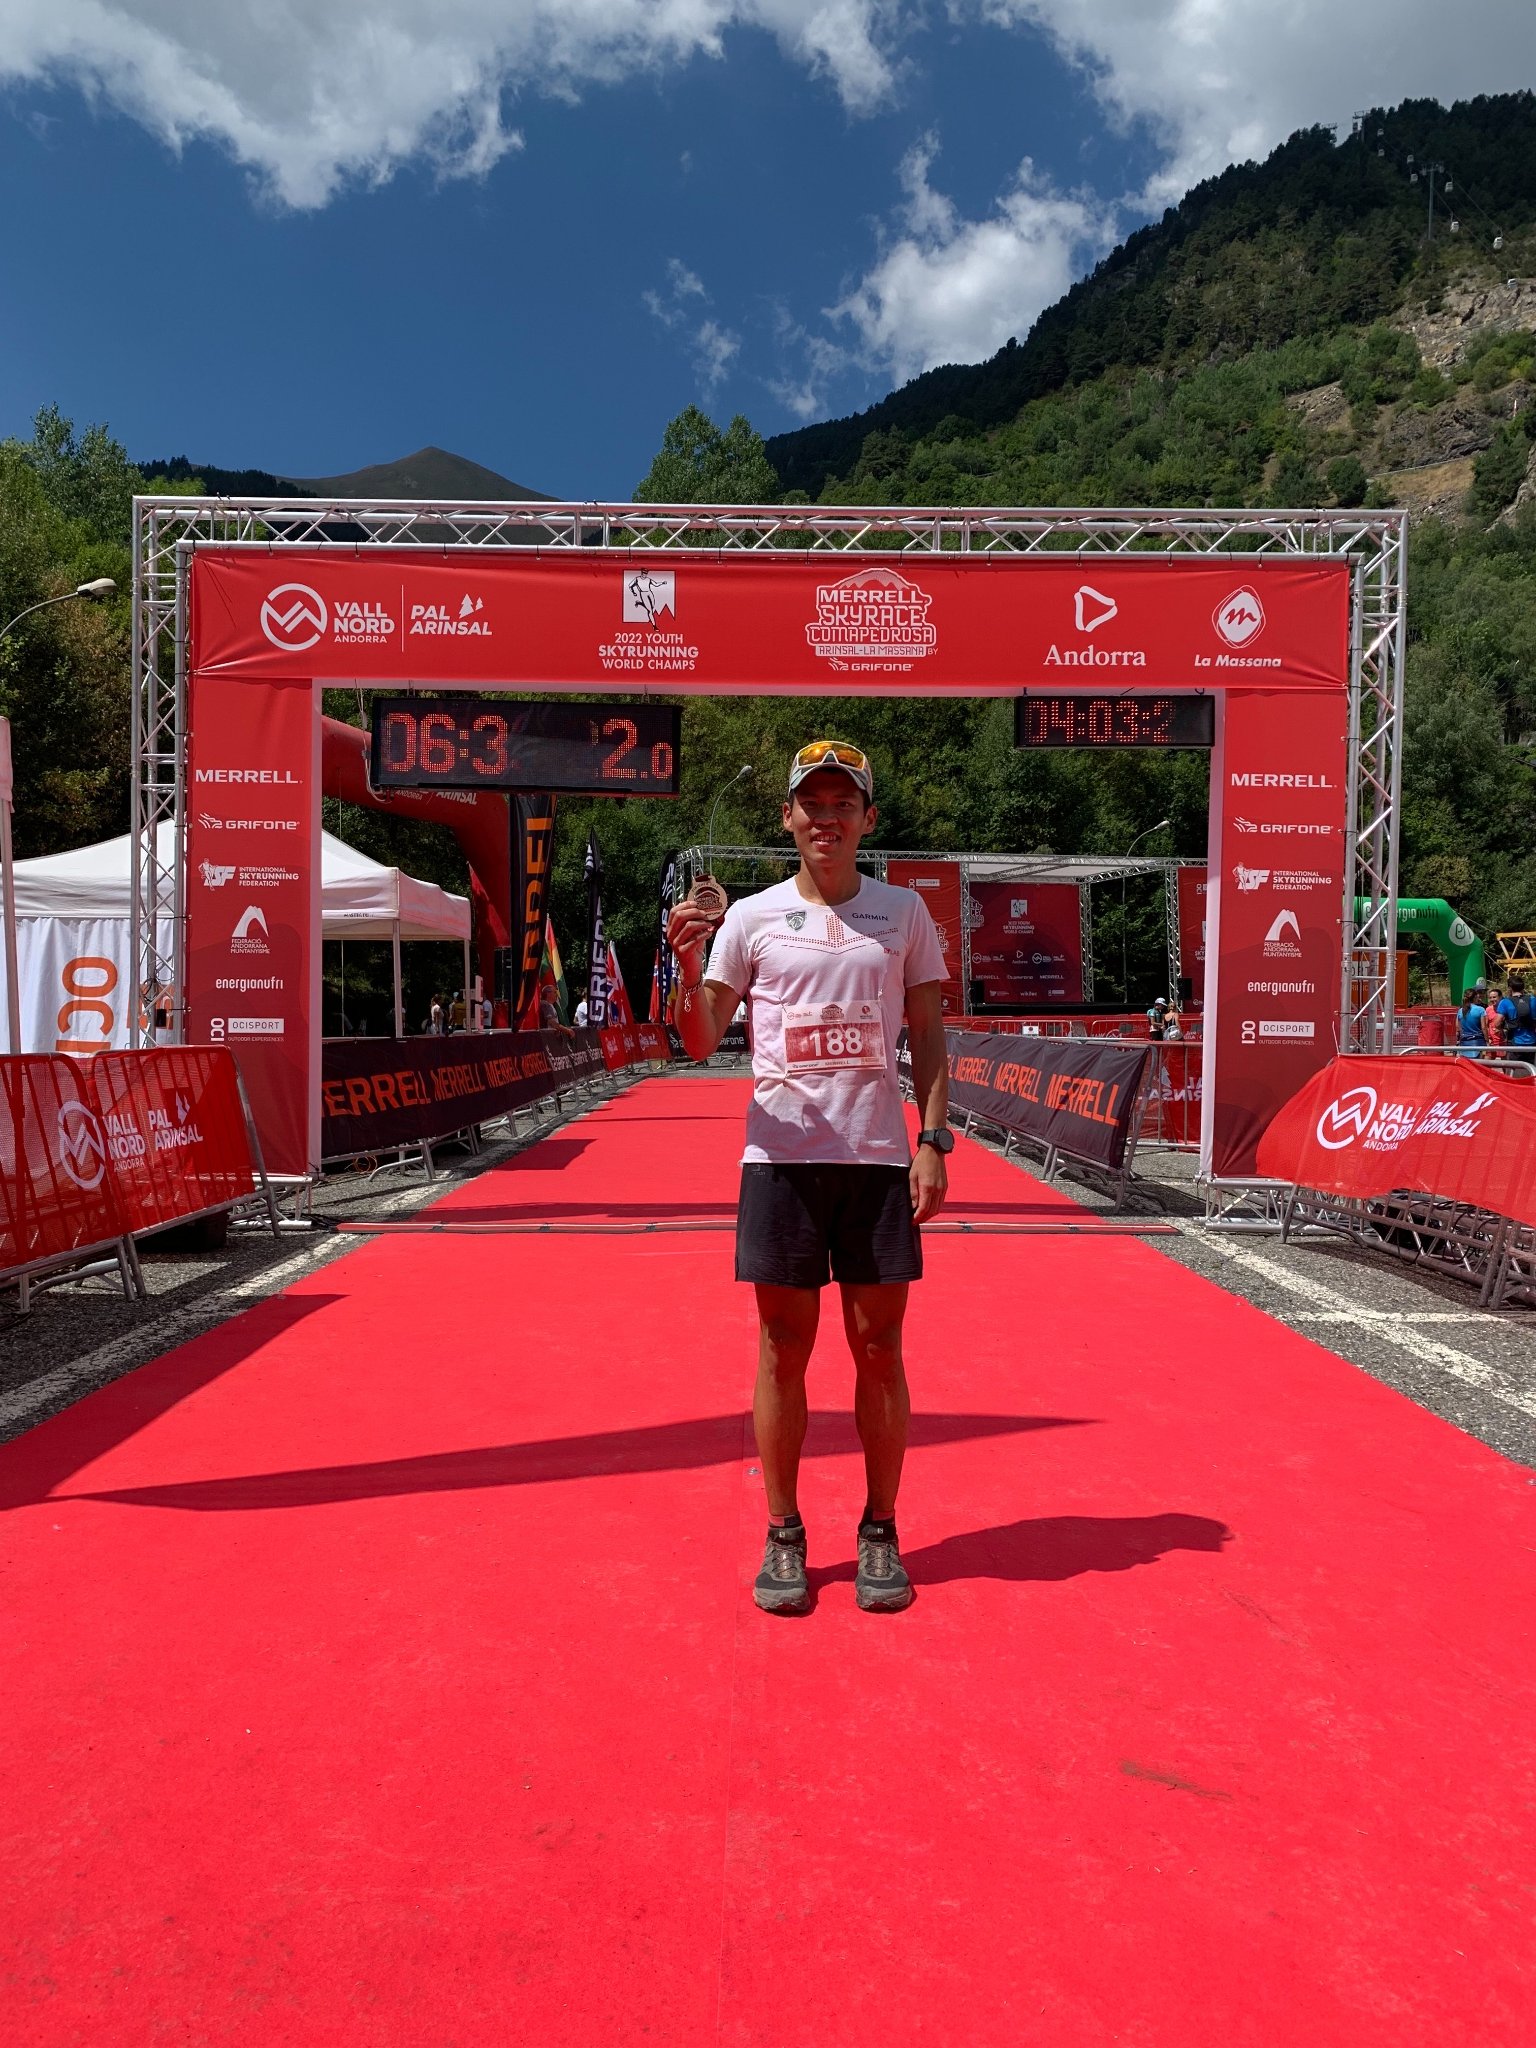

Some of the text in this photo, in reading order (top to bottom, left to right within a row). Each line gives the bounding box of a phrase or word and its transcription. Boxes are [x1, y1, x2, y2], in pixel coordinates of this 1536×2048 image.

[820, 589, 924, 604] MERRELL
[333, 602, 388, 618] VALL
[411, 605, 451, 620] PAL
[820, 604, 923, 626] SKYRACE
[333, 618, 395, 634] NORD
[410, 621, 493, 636] ARINSAL
[334, 635, 388, 643] ANDORRA
[614, 632, 684, 645] 2022 YOUTH
[810, 626, 933, 643] COMAPEDROSA
[598, 645, 699, 658] SKYRUNNING
[878, 645, 925, 656] MASSANA
[1043, 644, 1147, 667] Andorra
[602, 658, 696, 671] WORLD CHAMPS
[1194, 654, 1282, 667] La Massana
[195, 769, 299, 784] MERRELL
[1231, 773, 1333, 788] MERRELL
[239, 872, 300, 880] SKYRUNNING
[1272, 876, 1332, 885] SKYRUNNING
[851, 912, 889, 921] GARMIN
[215, 975, 284, 993] energianufri
[1247, 979, 1315, 996] energianufri
[56, 956, 118, 1051] OCI
[210, 1017, 225, 1042] OCI
[232, 1021, 280, 1030] OCISPORT
[1241, 1020, 1256, 1044] OCI
[1263, 1024, 1311, 1033] OCISPORT
[809, 1027, 863, 1057] 188
[322, 1070, 431, 1117] ERRELL
[954, 1057, 994, 1087] MERRELL
[994, 1062, 1043, 1103] MERRELL
[1044, 1073, 1120, 1127] MERRELL
[1424, 1101, 1459, 1119] PAL
[102, 1113, 138, 1137] VALL
[147, 1108, 173, 1131] PAL
[1411, 1118, 1482, 1138] ARINSAL
[154, 1123, 204, 1152] ARINSAL
[107, 1134, 146, 1160] NORD
